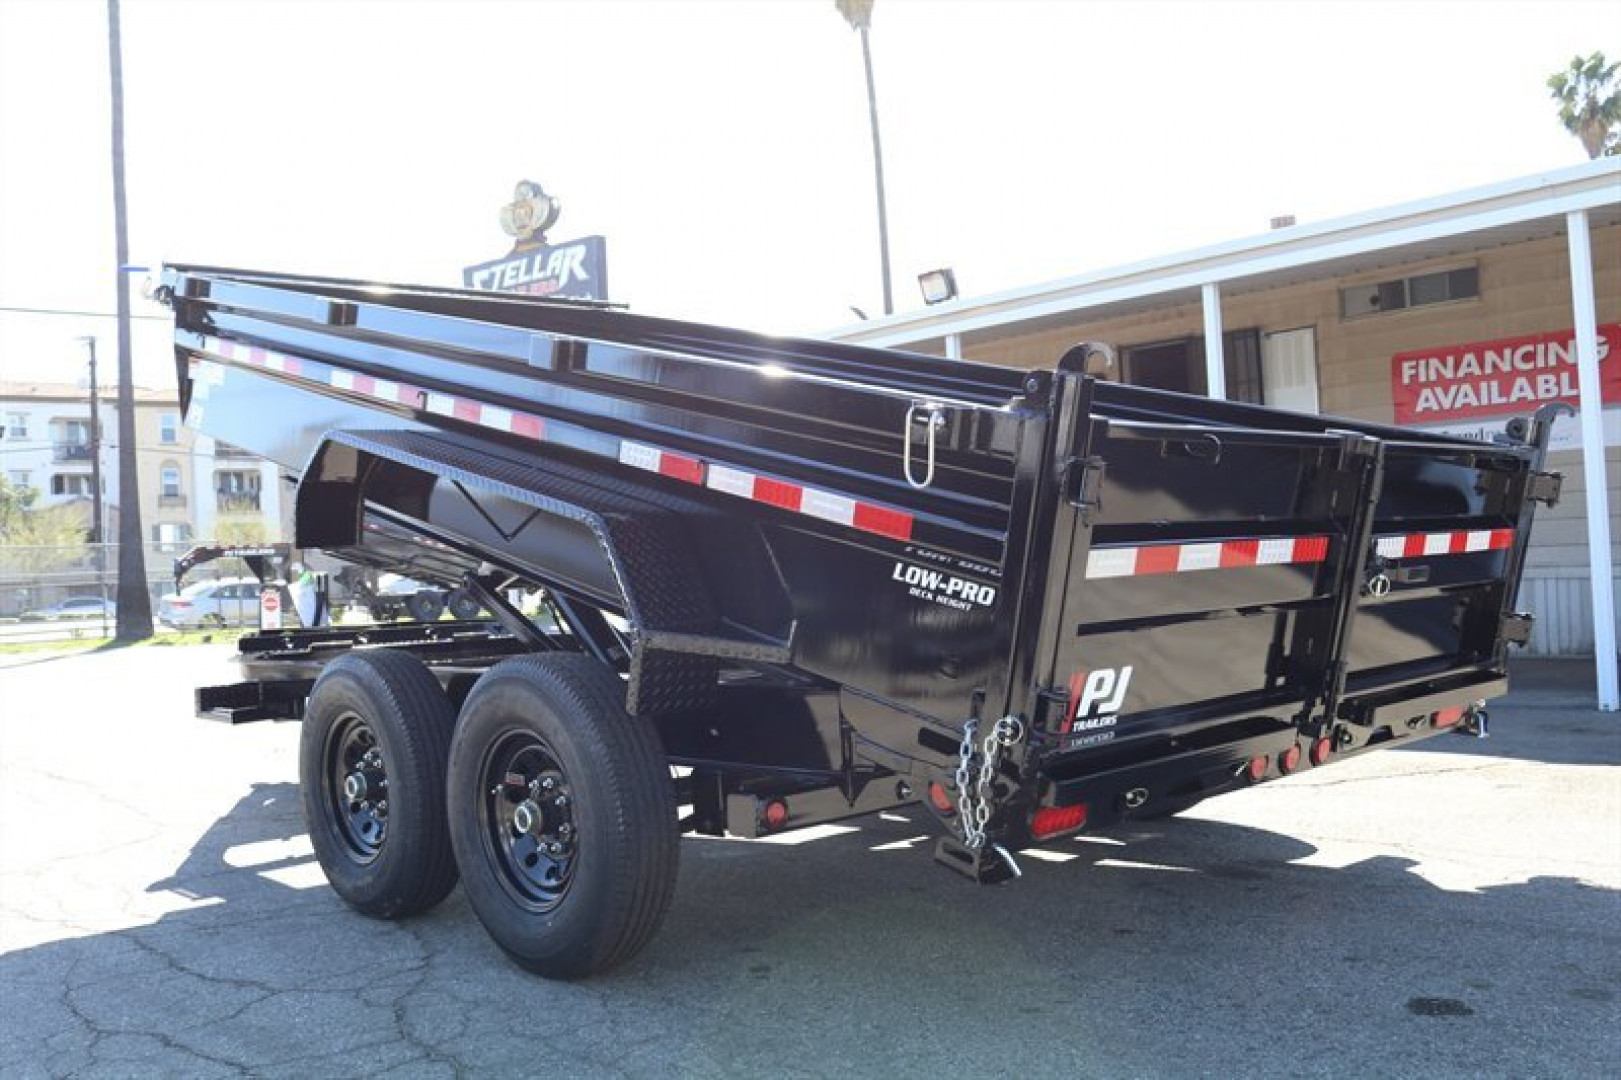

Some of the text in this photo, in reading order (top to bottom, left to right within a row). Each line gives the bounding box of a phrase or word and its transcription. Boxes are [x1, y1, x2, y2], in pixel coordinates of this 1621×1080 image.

[1415, 373, 1580, 412] AVAILABL
[892, 562, 996, 607] LOW-PRO
[1077, 665, 1134, 718] PJ
